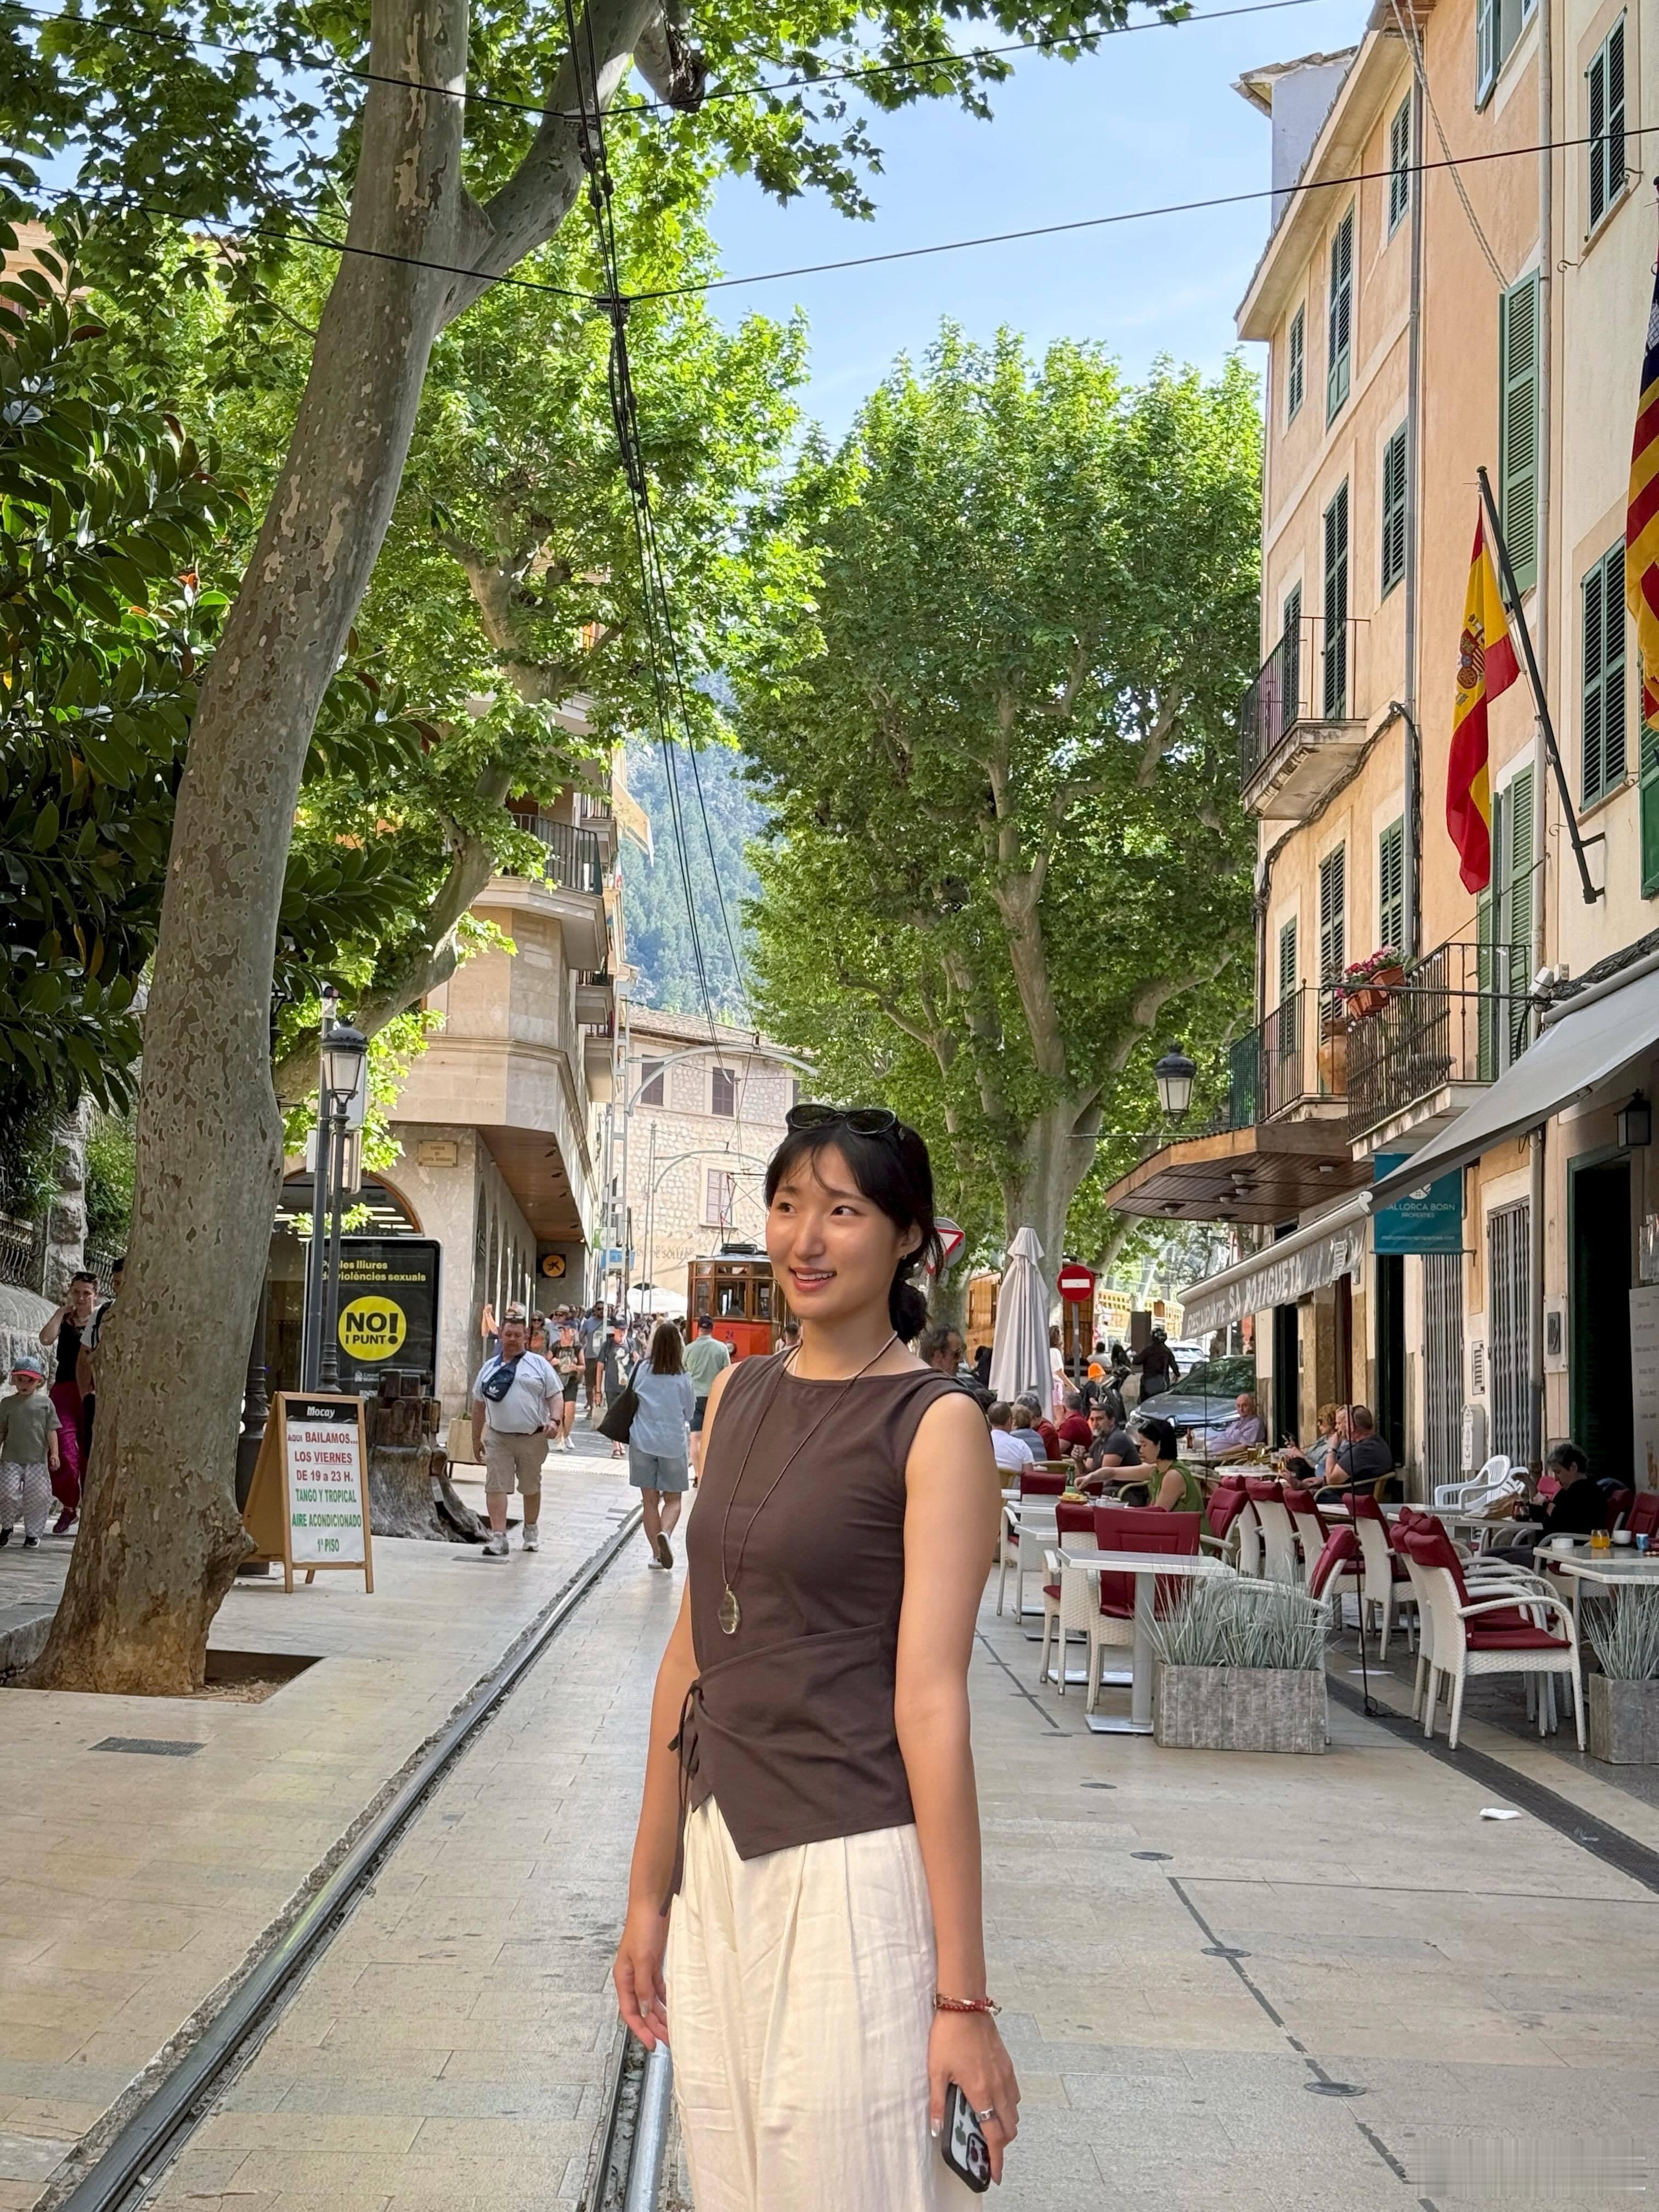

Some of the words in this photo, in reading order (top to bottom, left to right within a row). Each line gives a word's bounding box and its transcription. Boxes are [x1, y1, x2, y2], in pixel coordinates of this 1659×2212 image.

[357, 1260, 388, 1269] lliures
[388, 1273, 426, 1282] sexuals
[1229, 1284, 1240, 1319] SA
[345, 1335, 349, 1344] I
[352, 1335, 386, 1345] PUNT
[307, 1406, 335, 1419] Mocay
[295, 1451, 312, 1463] LOS
[314, 1452, 352, 1464] VIERNES
[296, 1470, 307, 1481] DE
[311, 1470, 321, 1481] 19
[323, 1473, 329, 1481] a
[331, 1471, 341, 1482] 23
[344, 1471, 353, 1482] H.
[295, 1488, 317, 1502] TANGO
[318, 1489, 323, 1503] Y
[325, 1489, 357, 1503] TROPICAL
[292, 1513, 307, 1527] AIRE
[309, 1514, 362, 1527] ACONDICIONADO
[325, 1538, 339, 1552] PISO
